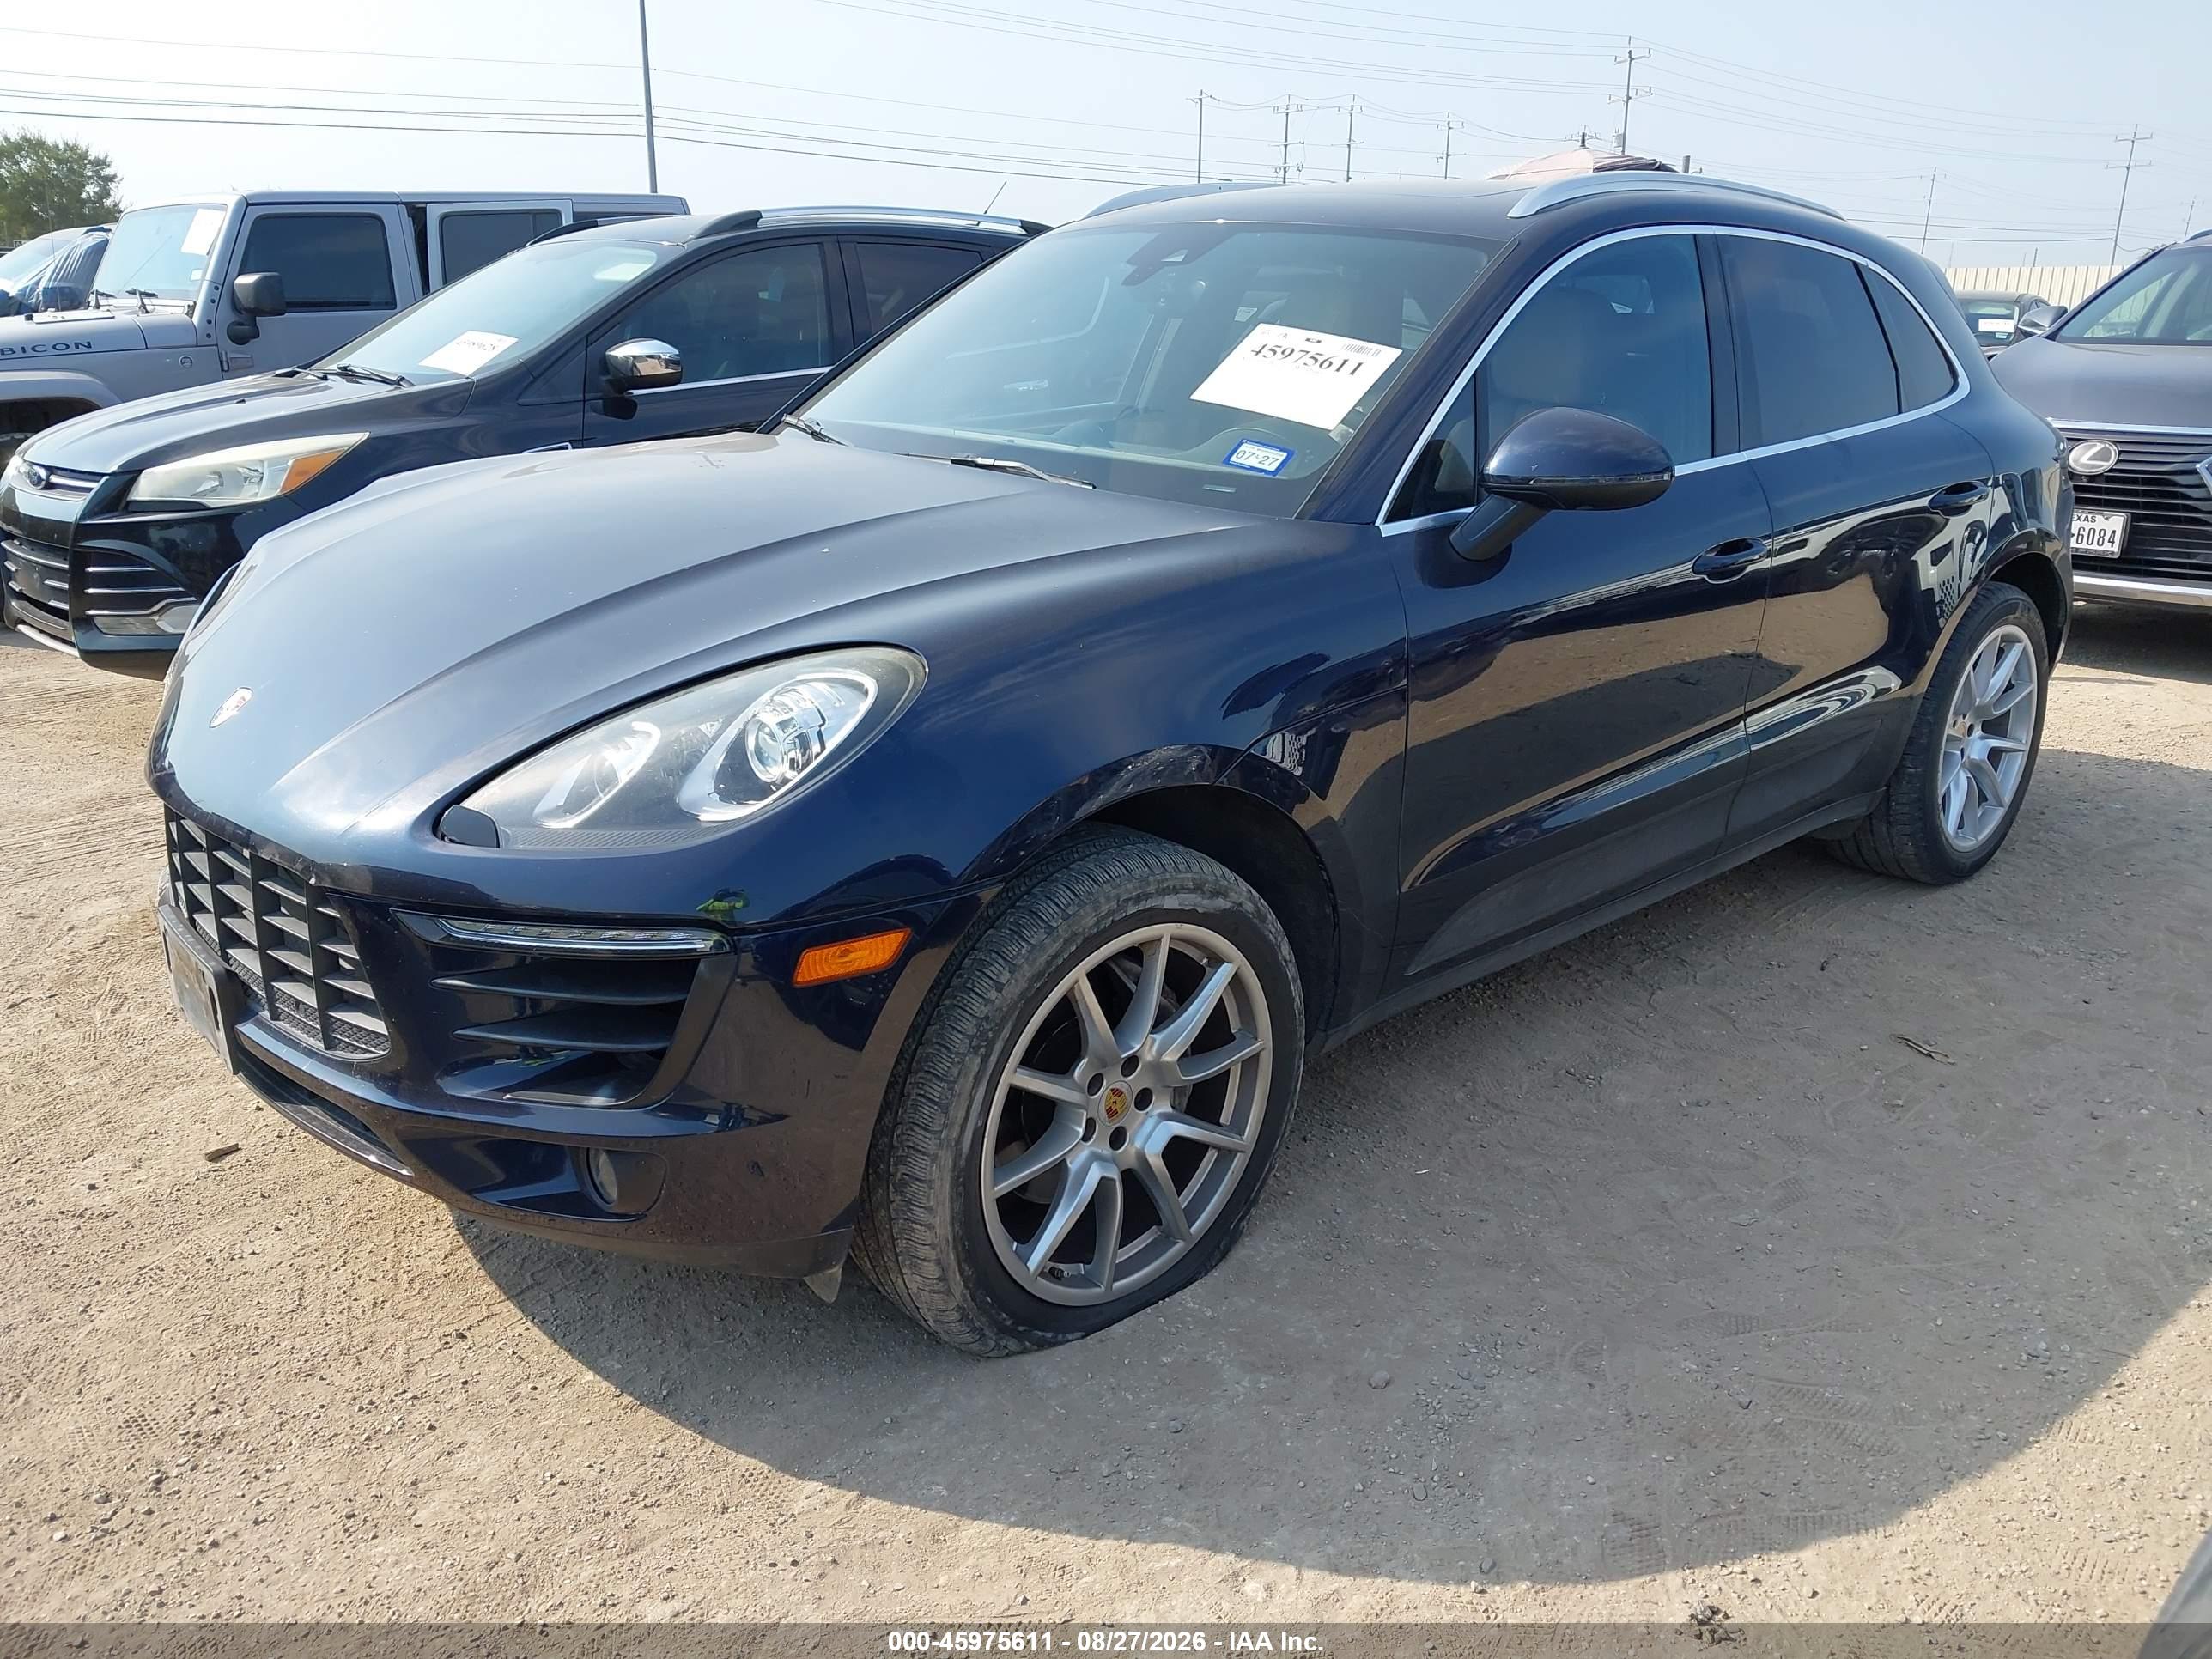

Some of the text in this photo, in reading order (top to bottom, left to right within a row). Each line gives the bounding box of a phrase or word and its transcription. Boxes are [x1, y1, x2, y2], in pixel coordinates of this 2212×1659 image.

[1250, 343, 1366, 376] 45975611
[1235, 449, 1256, 461] 07
[1257, 455, 1280, 467] 27
[2075, 526, 2118, 548] 6084
